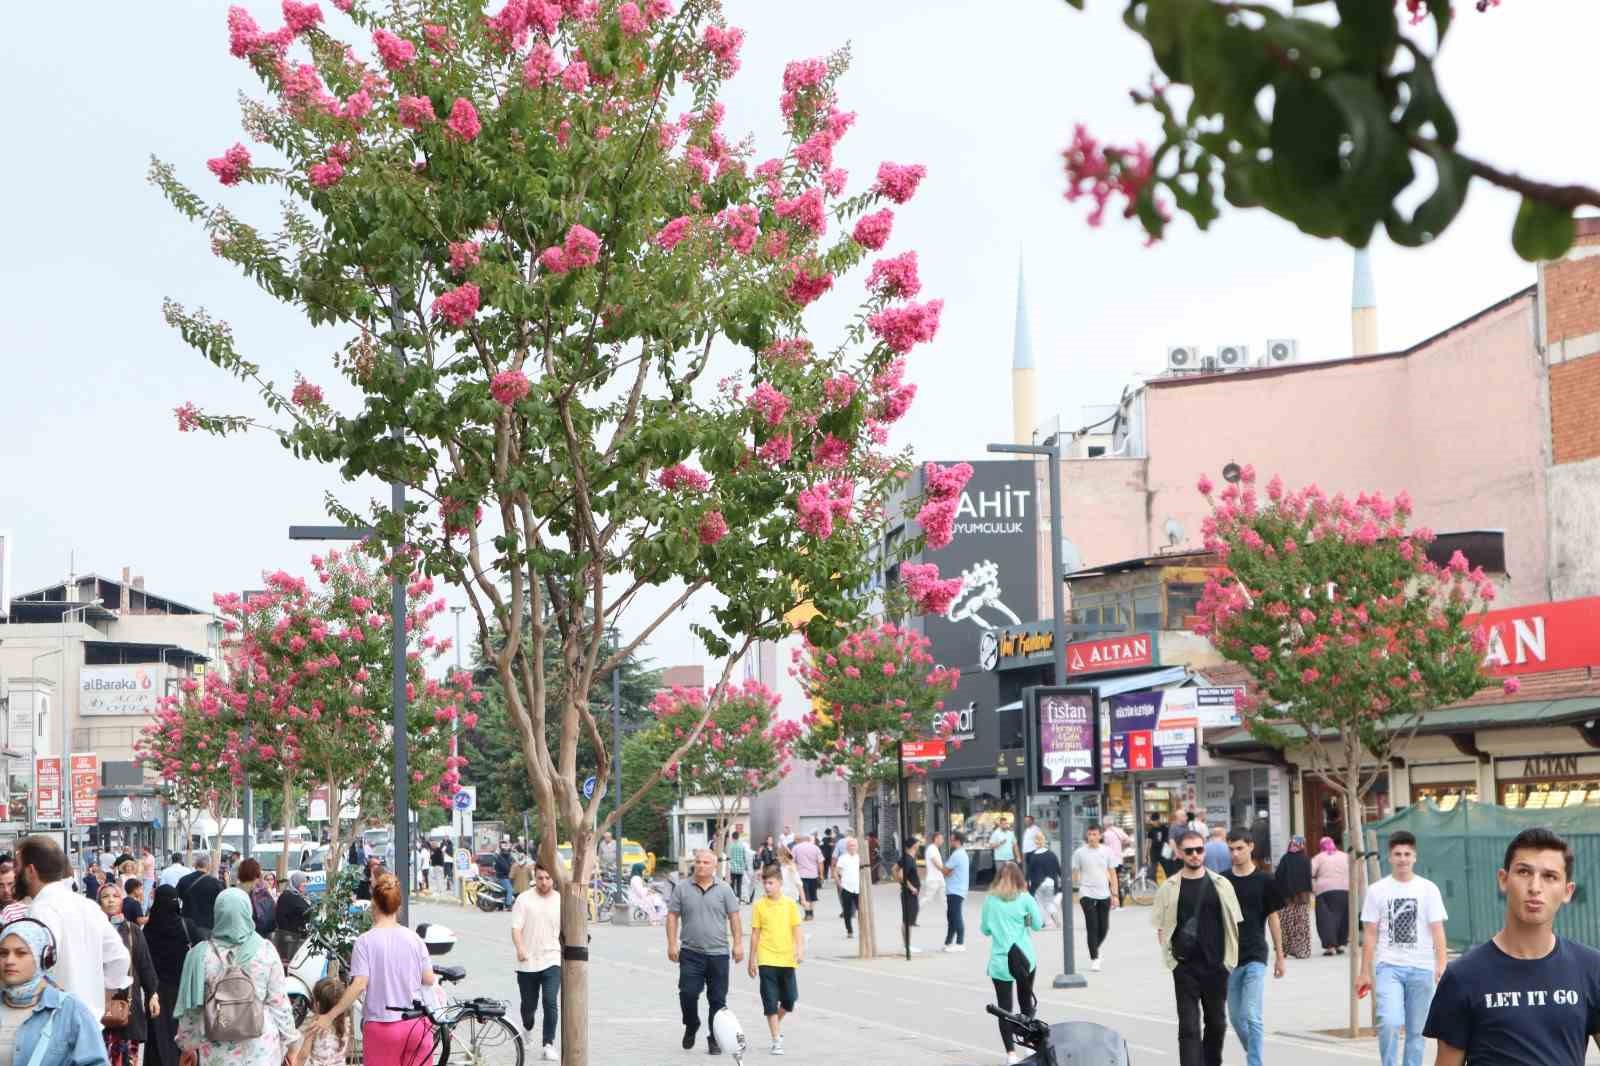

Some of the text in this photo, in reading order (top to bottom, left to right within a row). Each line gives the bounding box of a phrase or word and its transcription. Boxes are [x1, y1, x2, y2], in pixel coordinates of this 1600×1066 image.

[954, 484, 1031, 518] AHİT
[951, 522, 1024, 534] UYUMCULUK
[1090, 639, 1147, 663] ALTAN
[83, 677, 137, 690] alBaraka
[1523, 755, 1579, 777] ALTAN
[1485, 989, 1579, 1009] LET IT GO
